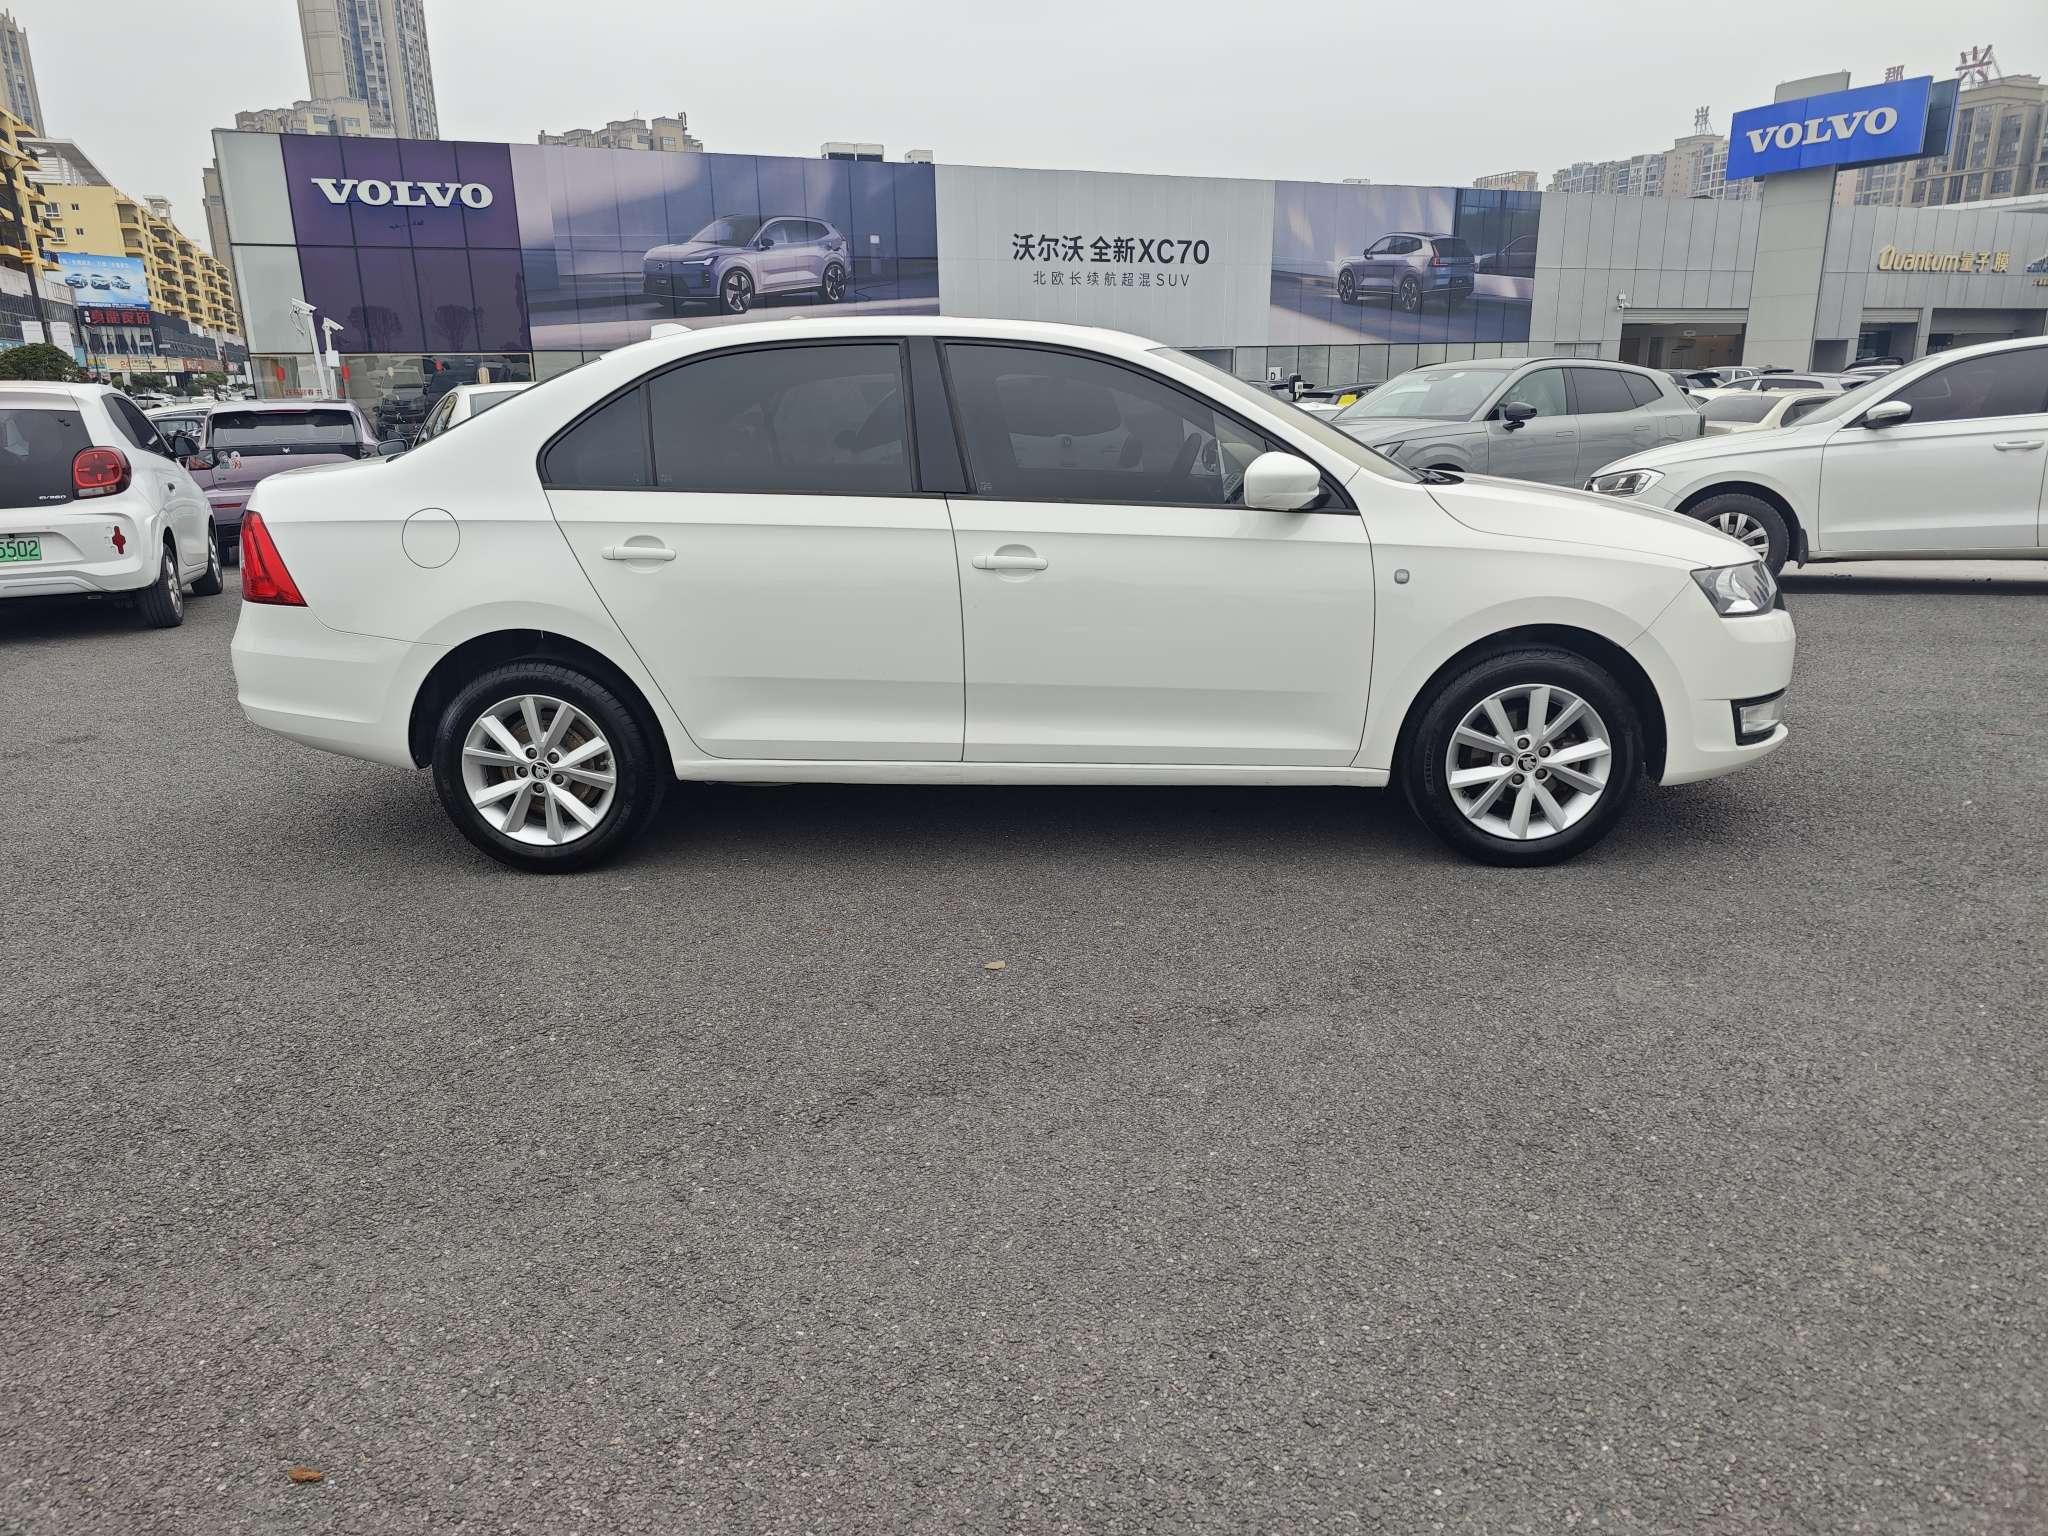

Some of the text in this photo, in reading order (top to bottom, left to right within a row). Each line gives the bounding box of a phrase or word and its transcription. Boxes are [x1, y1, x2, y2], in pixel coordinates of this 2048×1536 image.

[1746, 106, 1899, 154] VOLVO
[310, 177, 494, 210] VOLVO
[1012, 233, 1210, 265] 沃尔沃 全新XC70
[1878, 243, 2010, 273] Quantum 量子膜
[1032, 270, 1190, 288] 北欧长续航超混SUV
